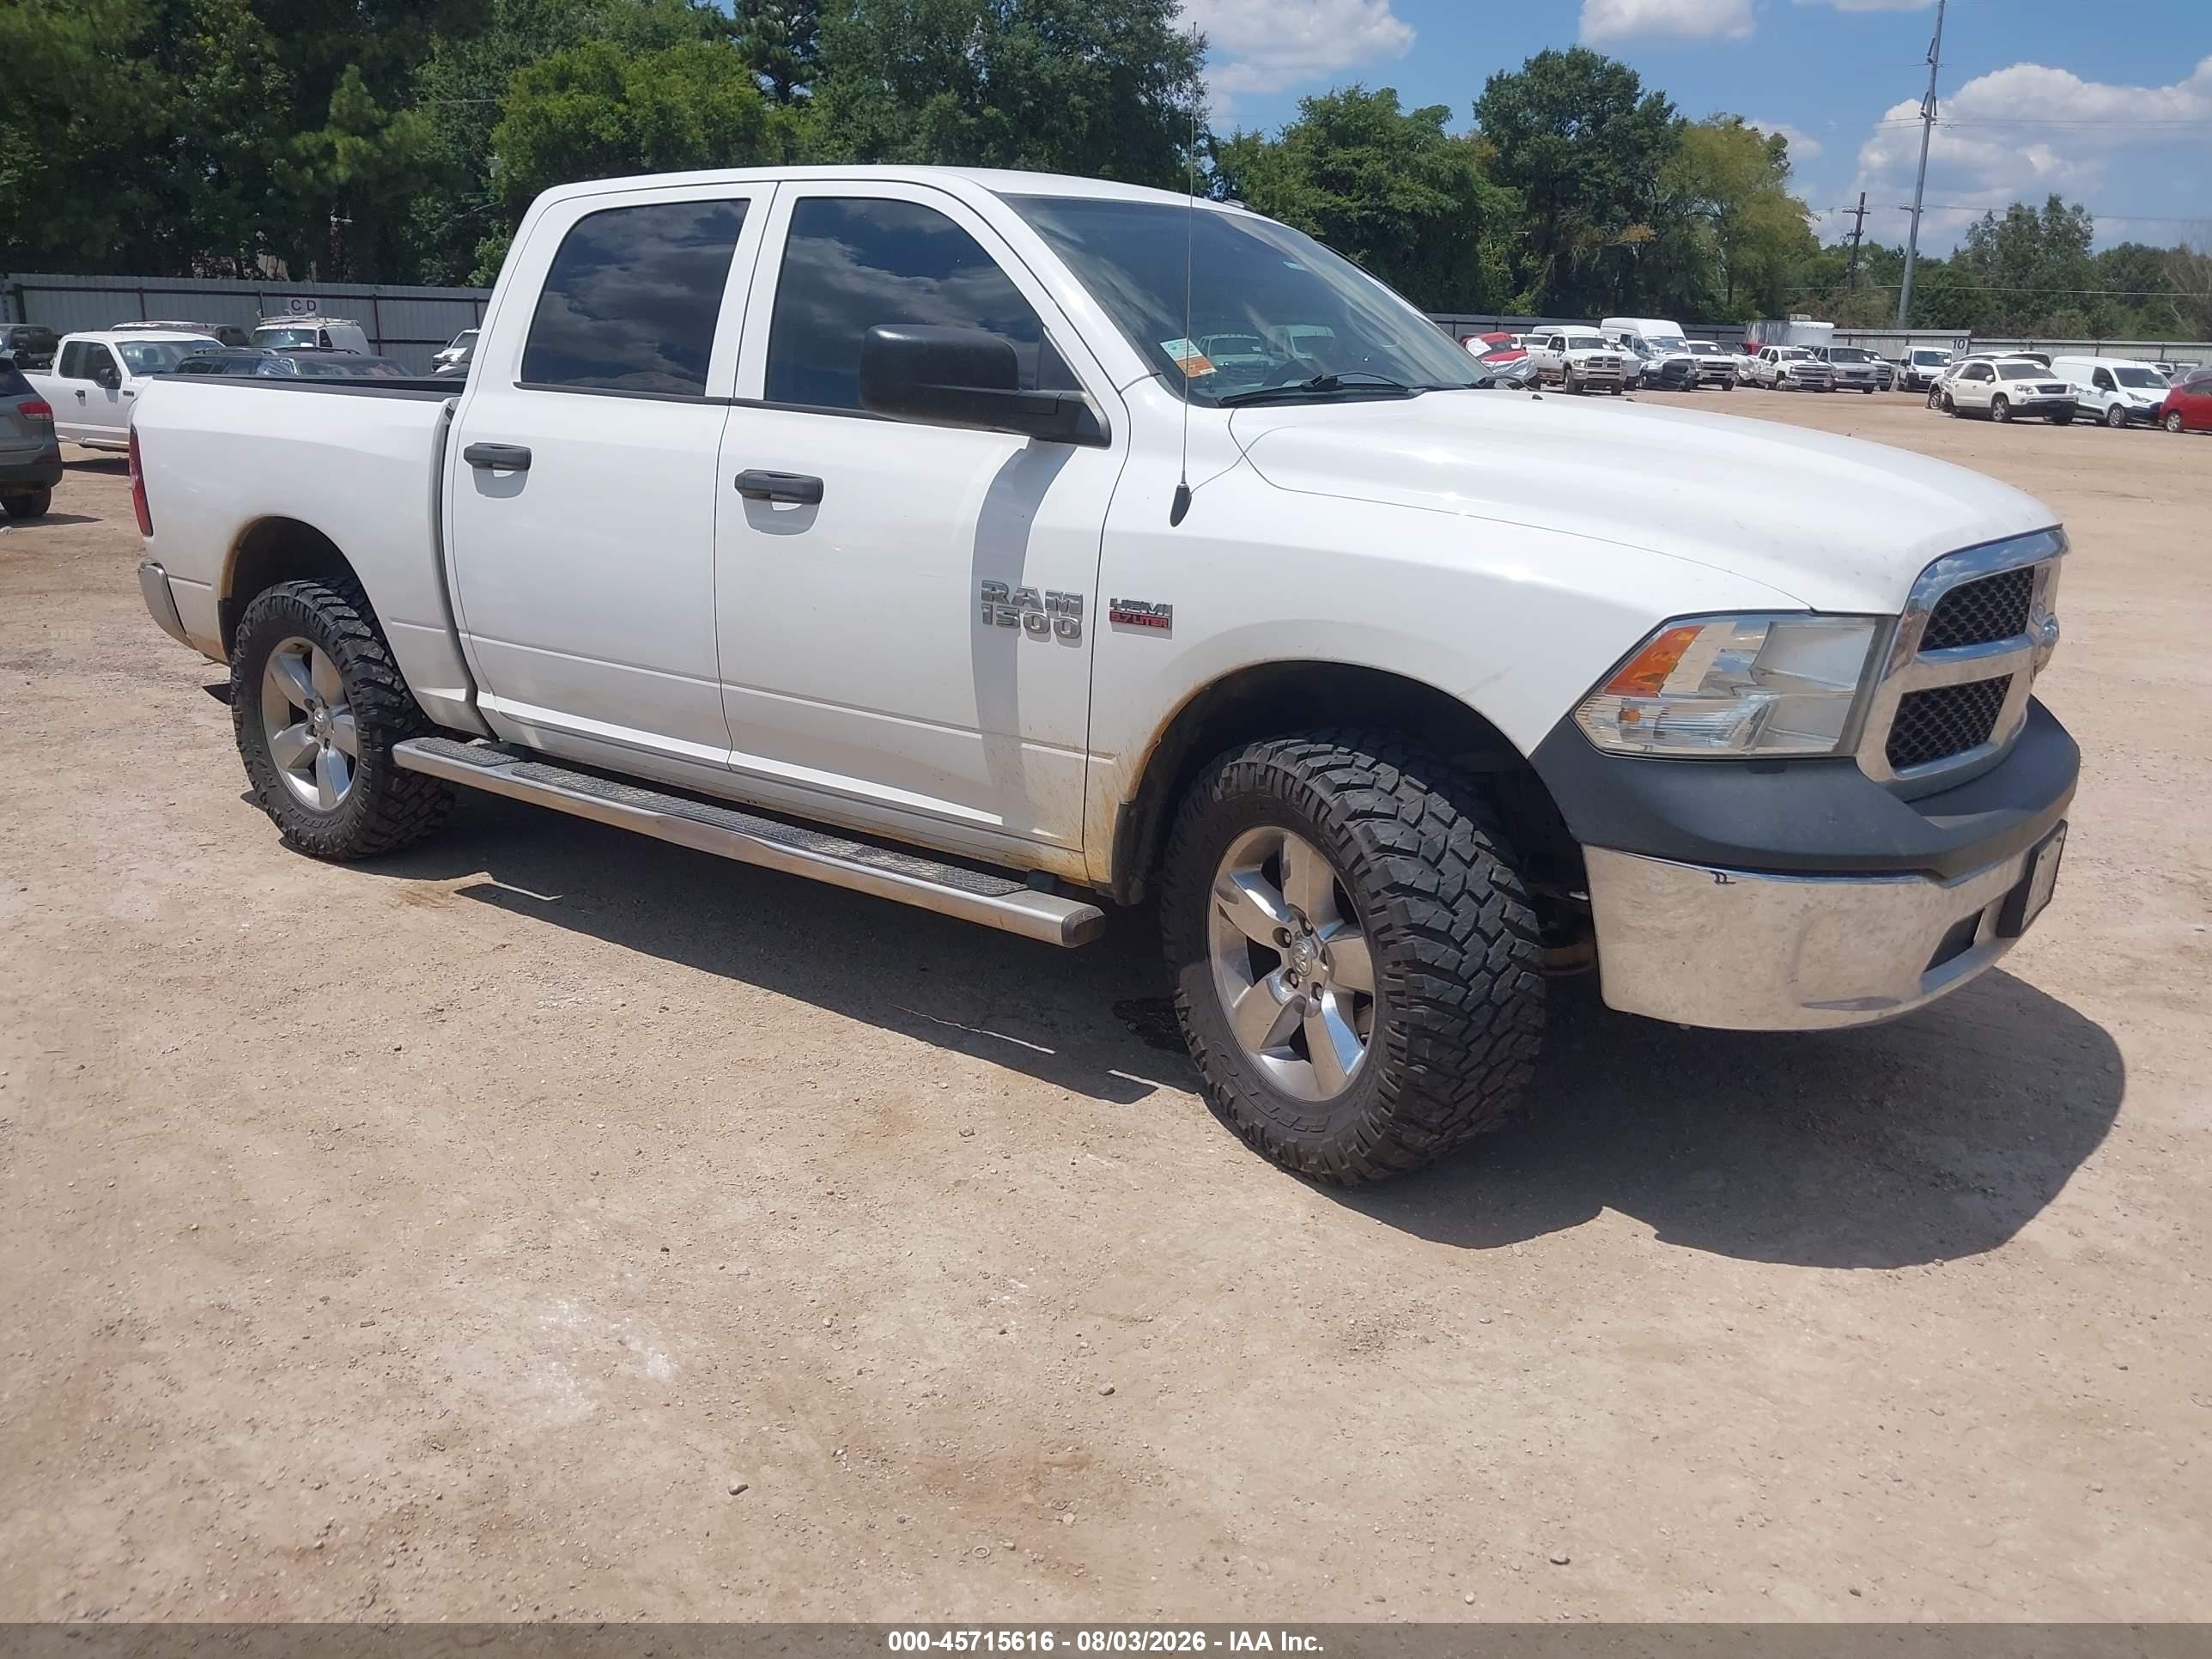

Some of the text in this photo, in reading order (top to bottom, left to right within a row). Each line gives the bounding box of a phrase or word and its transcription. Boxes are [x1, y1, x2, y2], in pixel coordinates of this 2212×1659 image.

[1951, 338, 1966, 350] 10
[981, 580, 1083, 614] RAM
[1109, 597, 1173, 618] HEMI
[981, 603, 1082, 639] 1500
